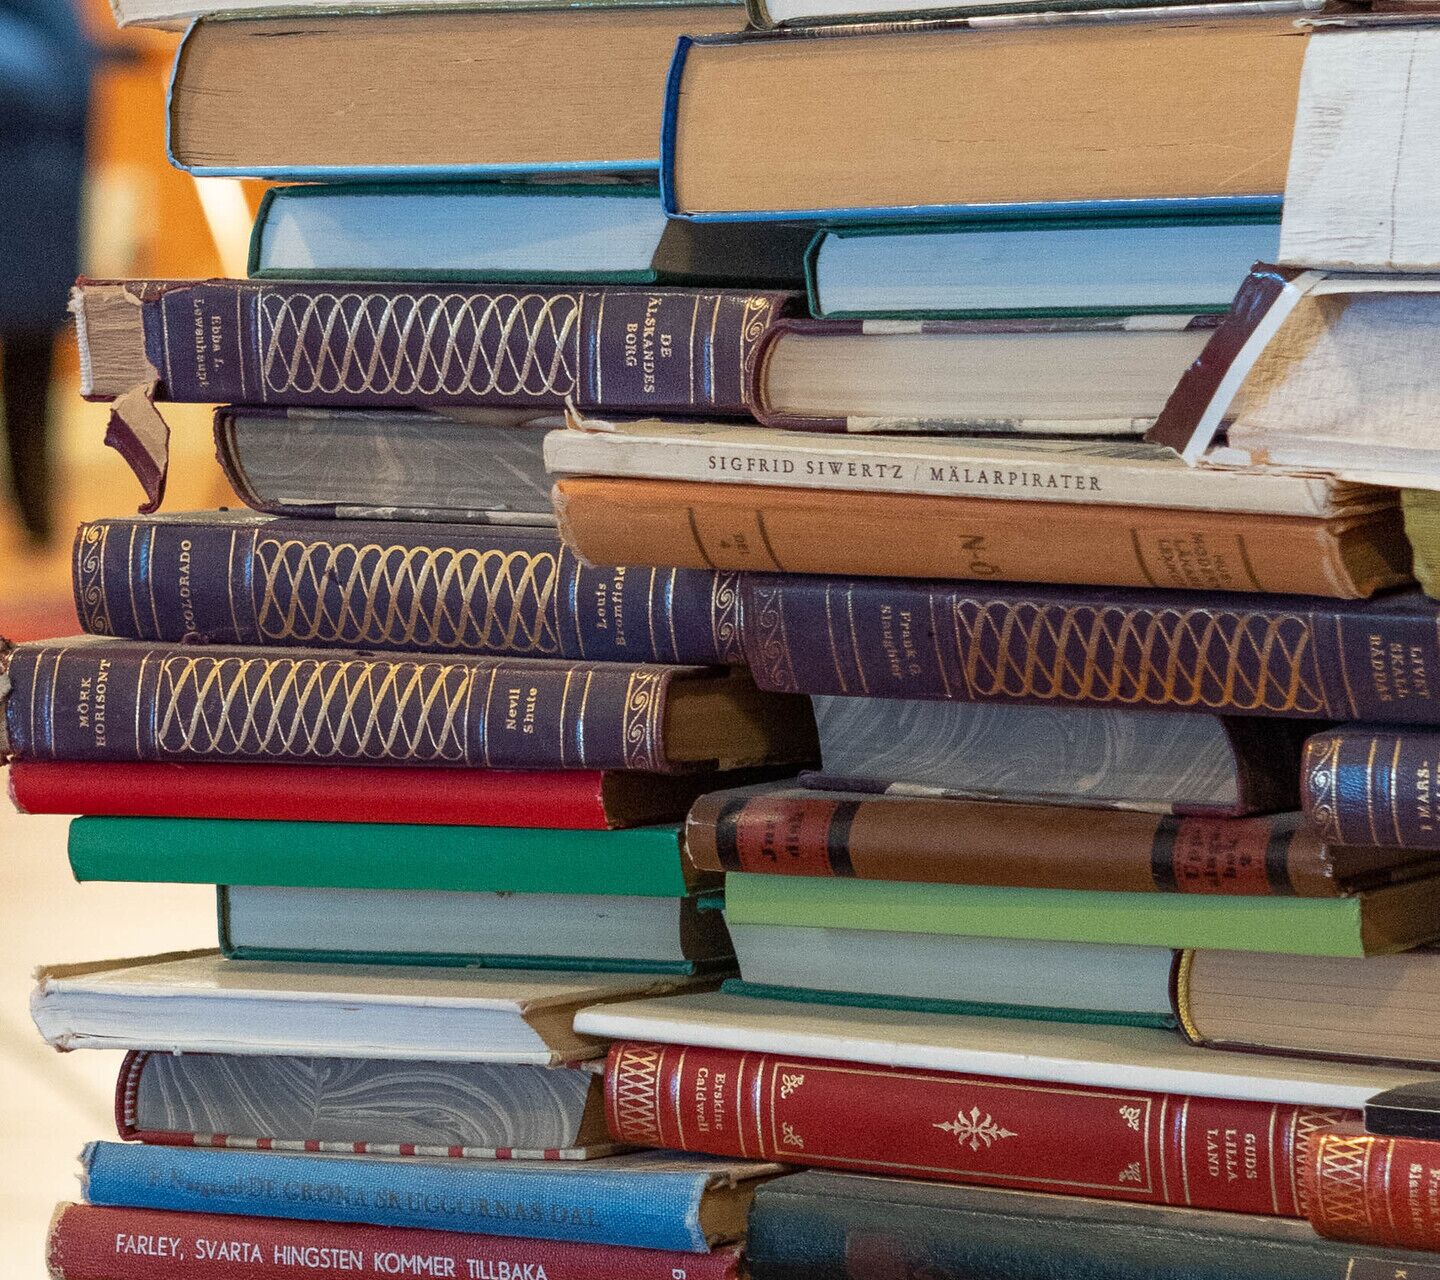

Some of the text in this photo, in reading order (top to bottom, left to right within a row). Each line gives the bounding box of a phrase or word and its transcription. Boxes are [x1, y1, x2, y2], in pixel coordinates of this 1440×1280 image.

[211, 315, 222, 352] Ebba
[625, 323, 639, 367] BORG
[643, 297, 663, 393] ÄLSKANDES
[660, 333, 672, 358] DE
[707, 454, 796, 475] SIGFRID
[806, 459, 904, 480] SIWERTZ
[929, 465, 1103, 493] MÄLARPIRATER
[179, 539, 196, 631] COLORADO
[595, 582, 608, 629] Louis
[611, 566, 627, 646] Bromfield
[76, 677, 92, 728] MÖRK
[94, 658, 112, 747] HORISONT
[505, 688, 521, 731] Nevil
[522, 687, 538, 734] Shute
[695, 1066, 710, 1133] Caldwell
[713, 1073, 727, 1131] Erskine
[1206, 1128, 1220, 1177] LAND
[1225, 1128, 1238, 1183] LILLA
[1244, 1133, 1258, 1179] GUDS
[115, 1233, 186, 1261] FARLEY,
[195, 1239, 263, 1263] SVARTA
[273, 1246, 363, 1272] HINGSTEN
[373, 1251, 457, 1278] KOMMER
